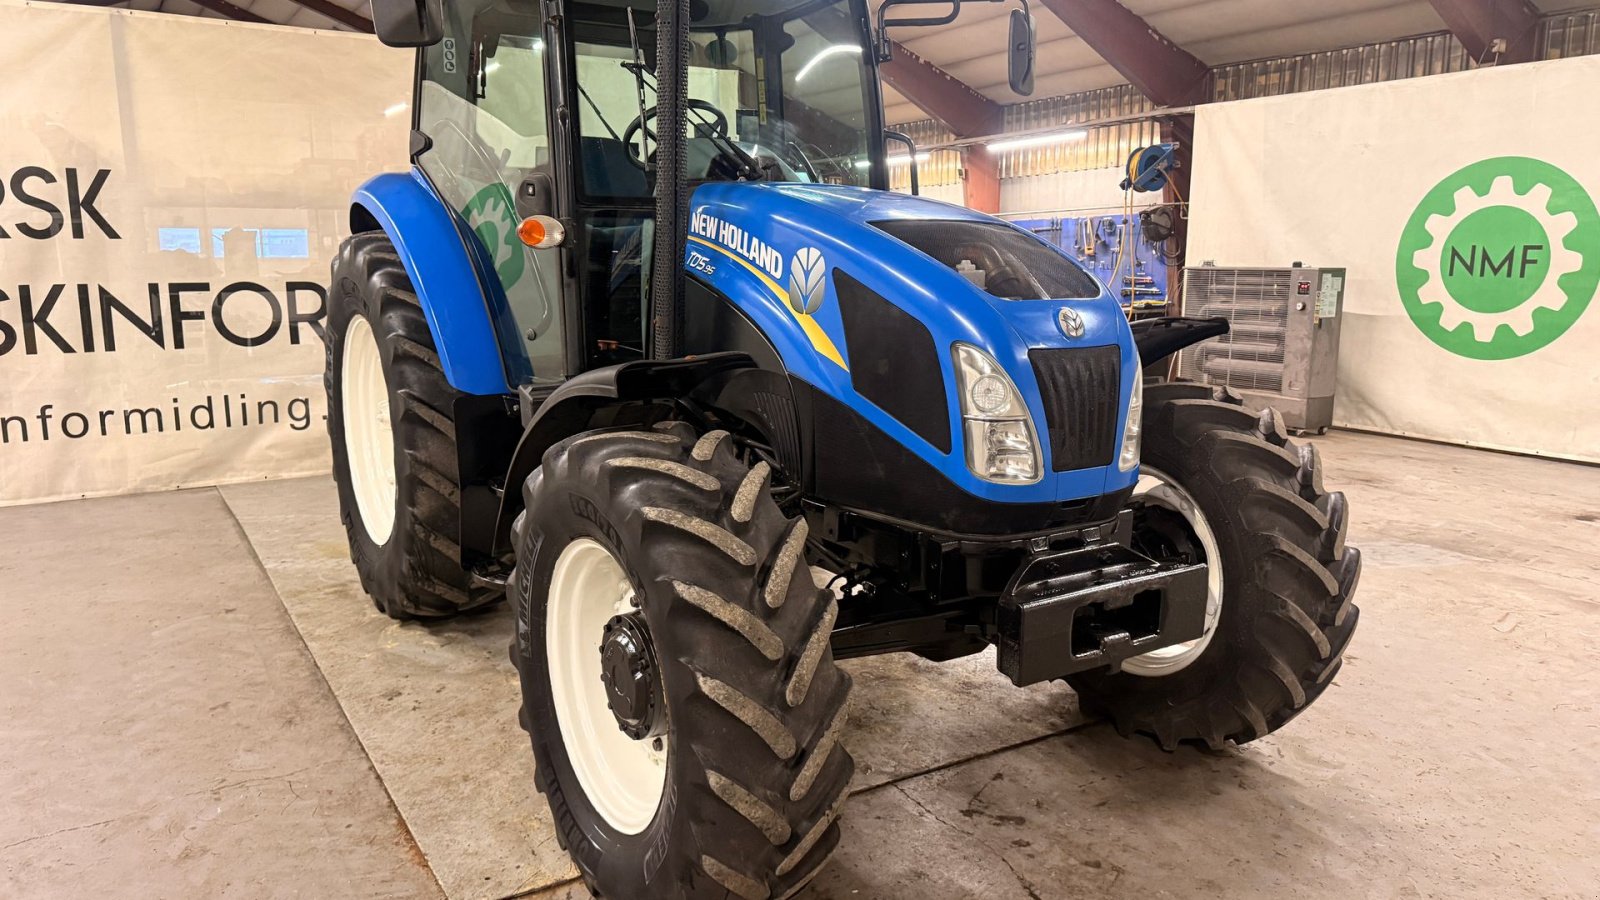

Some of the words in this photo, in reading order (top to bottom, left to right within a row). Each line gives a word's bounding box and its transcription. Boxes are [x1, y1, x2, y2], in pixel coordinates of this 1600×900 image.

[0, 166, 122, 239] SK
[691, 212, 718, 239] NEW
[719, 220, 783, 279] HOLLAND
[1448, 245, 1543, 278] NMF
